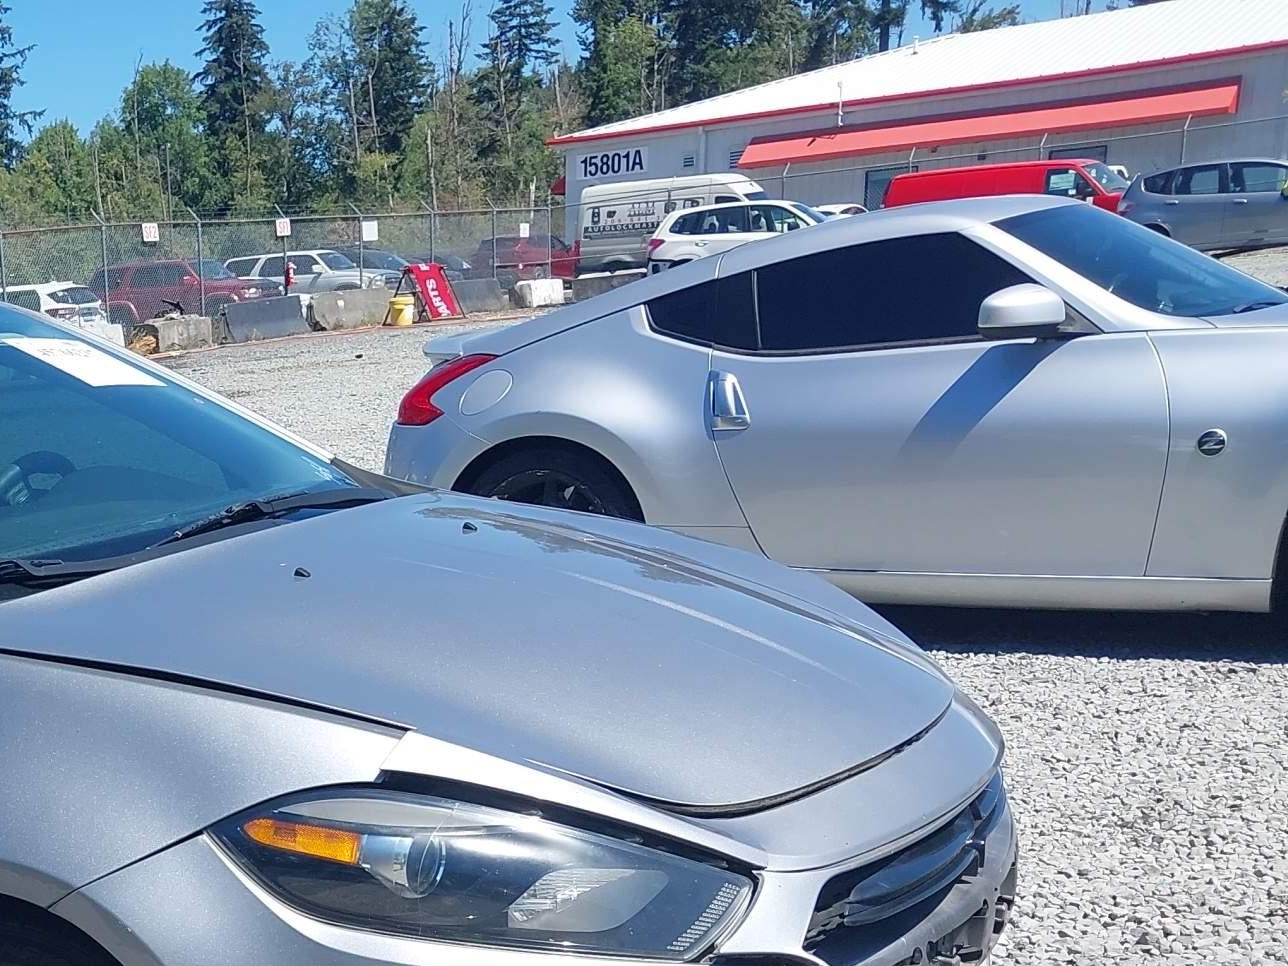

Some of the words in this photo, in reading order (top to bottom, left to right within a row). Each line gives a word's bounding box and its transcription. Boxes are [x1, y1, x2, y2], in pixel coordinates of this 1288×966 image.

[580, 149, 644, 178] 15801A
[144, 225, 158, 240] SF2
[587, 221, 659, 232] AUTOLOCKMAST
[425, 278, 452, 318] ARTS
